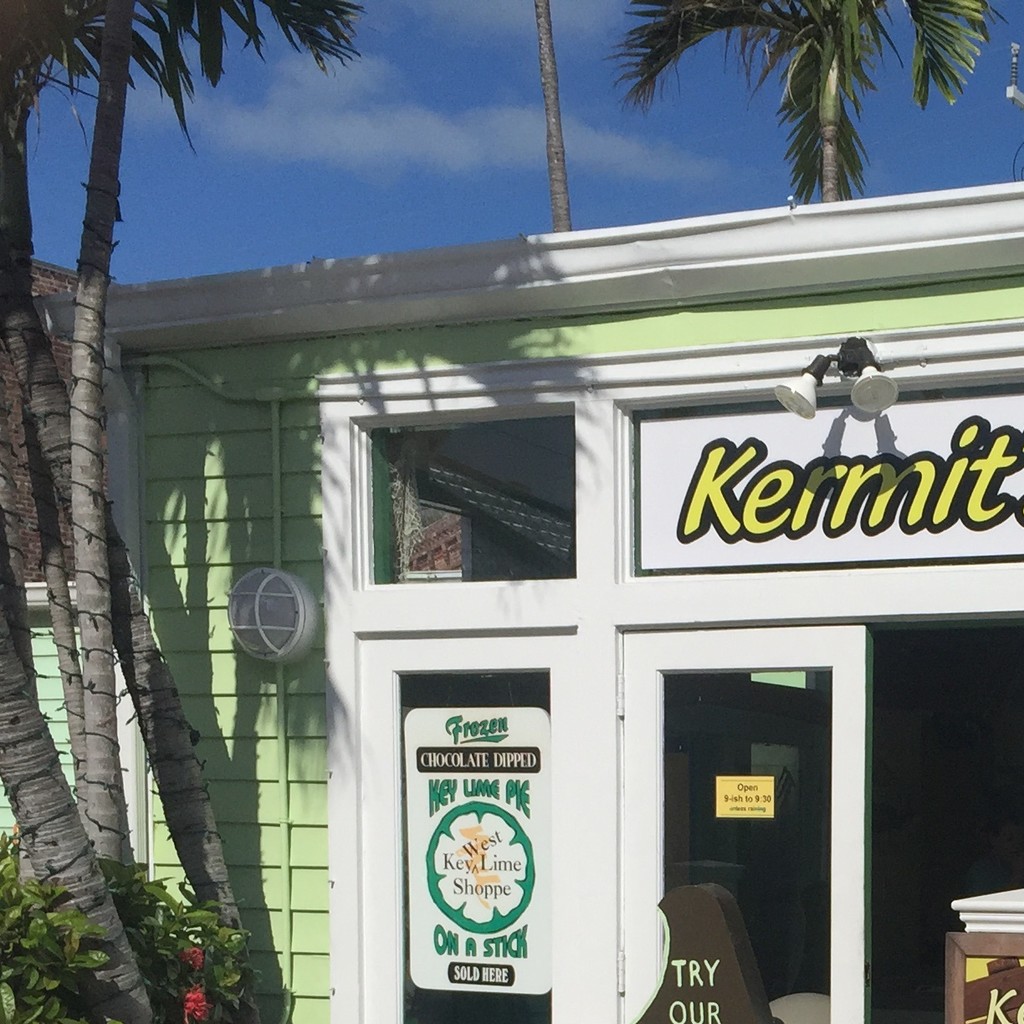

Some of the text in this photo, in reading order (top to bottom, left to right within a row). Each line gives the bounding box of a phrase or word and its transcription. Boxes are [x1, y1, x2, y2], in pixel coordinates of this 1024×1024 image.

[446, 715, 509, 744] Frozen
[421, 752, 537, 768] CHOCOLATE DIPPED
[724, 794, 772, 803] 9-ish to 9:30
[737, 783, 758, 792] Open
[428, 779, 531, 819] KEY LIME PIE
[462, 830, 504, 859] West
[443, 853, 522, 875] Key Lime
[453, 878, 512, 899] Shoppe
[433, 924, 529, 959] ON A STICK
[454, 965, 509, 983] SOLD HERE
[671, 959, 720, 988] TRY
